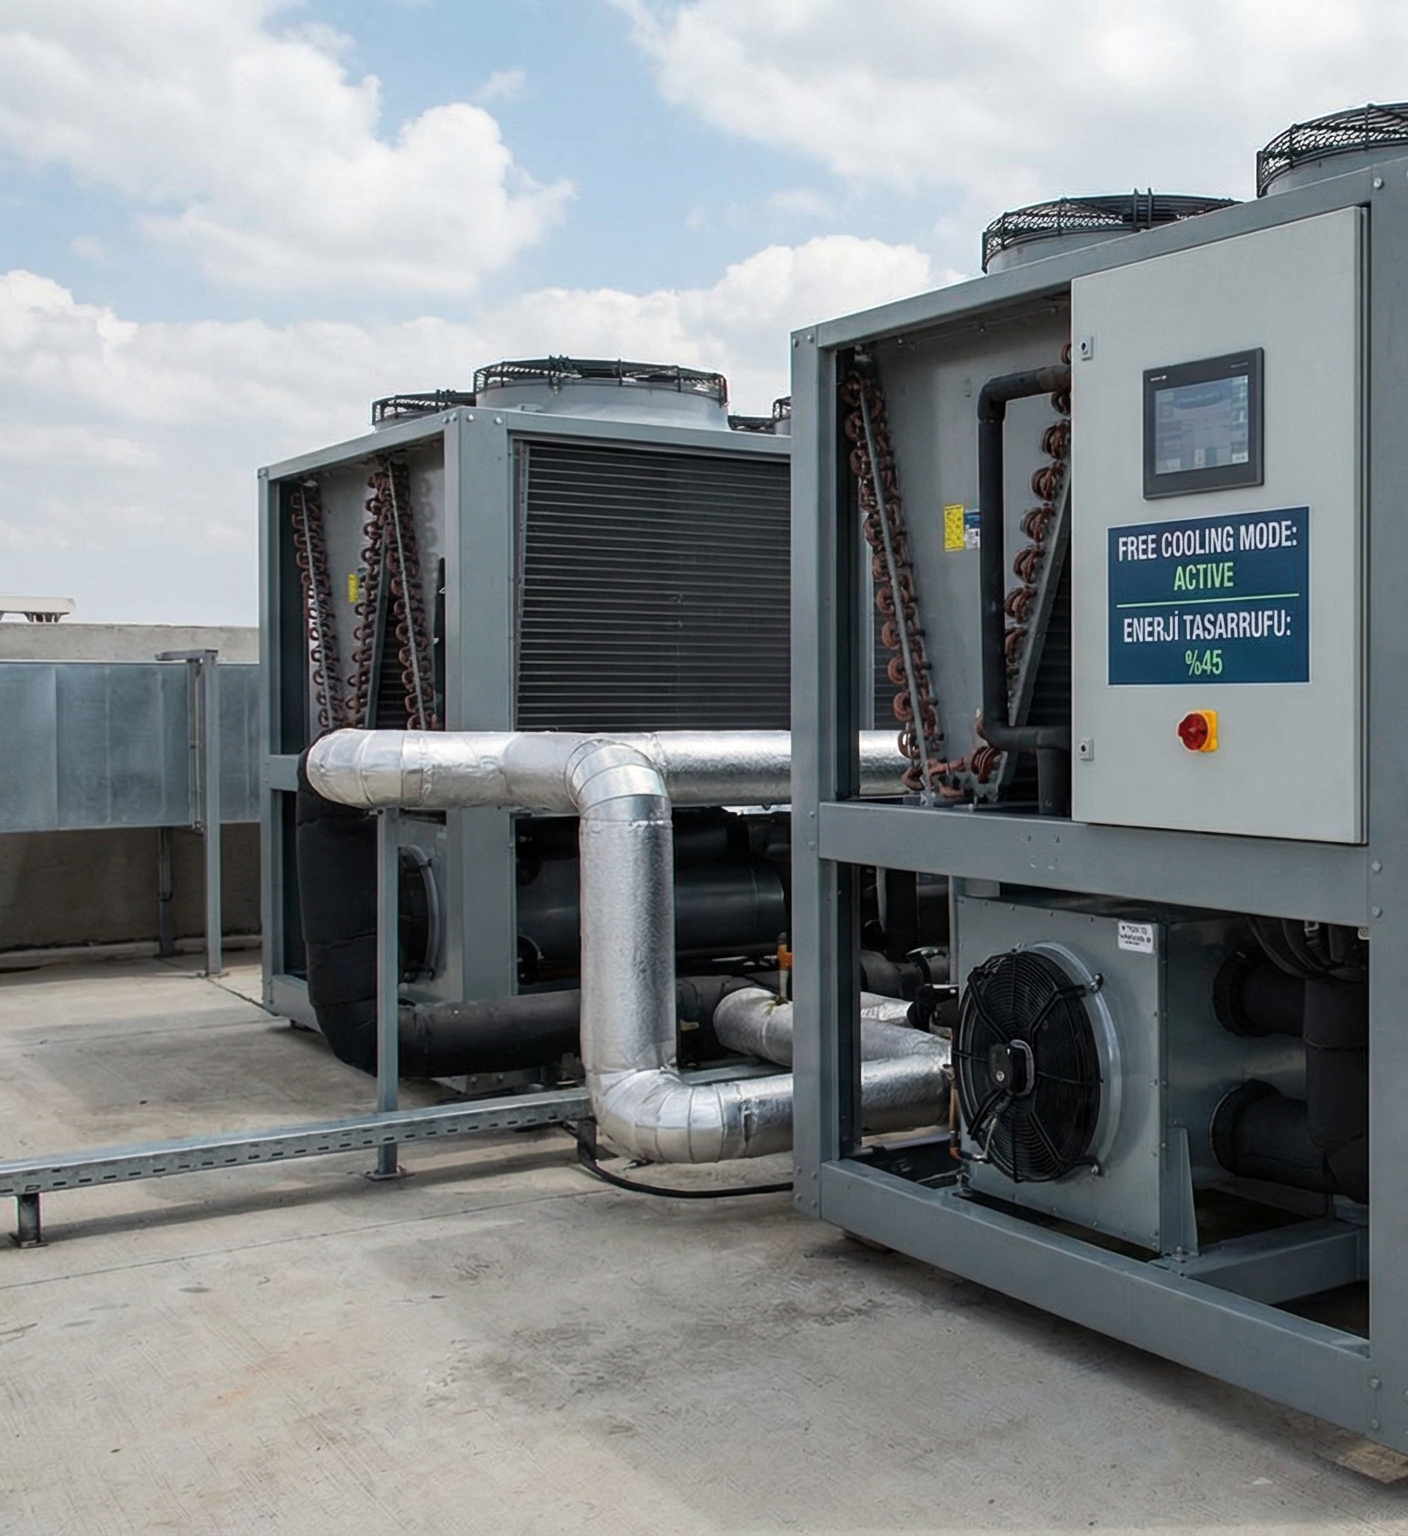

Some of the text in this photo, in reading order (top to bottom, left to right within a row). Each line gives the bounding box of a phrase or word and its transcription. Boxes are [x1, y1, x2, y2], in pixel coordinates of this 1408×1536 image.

[1118, 520, 1297, 562] FREE COOLING MODE:
[1173, 562, 1234, 590] ACTIVE
[1123, 609, 1291, 642] ENERJİ TASARRUFU:
[1185, 649, 1223, 675] %45
